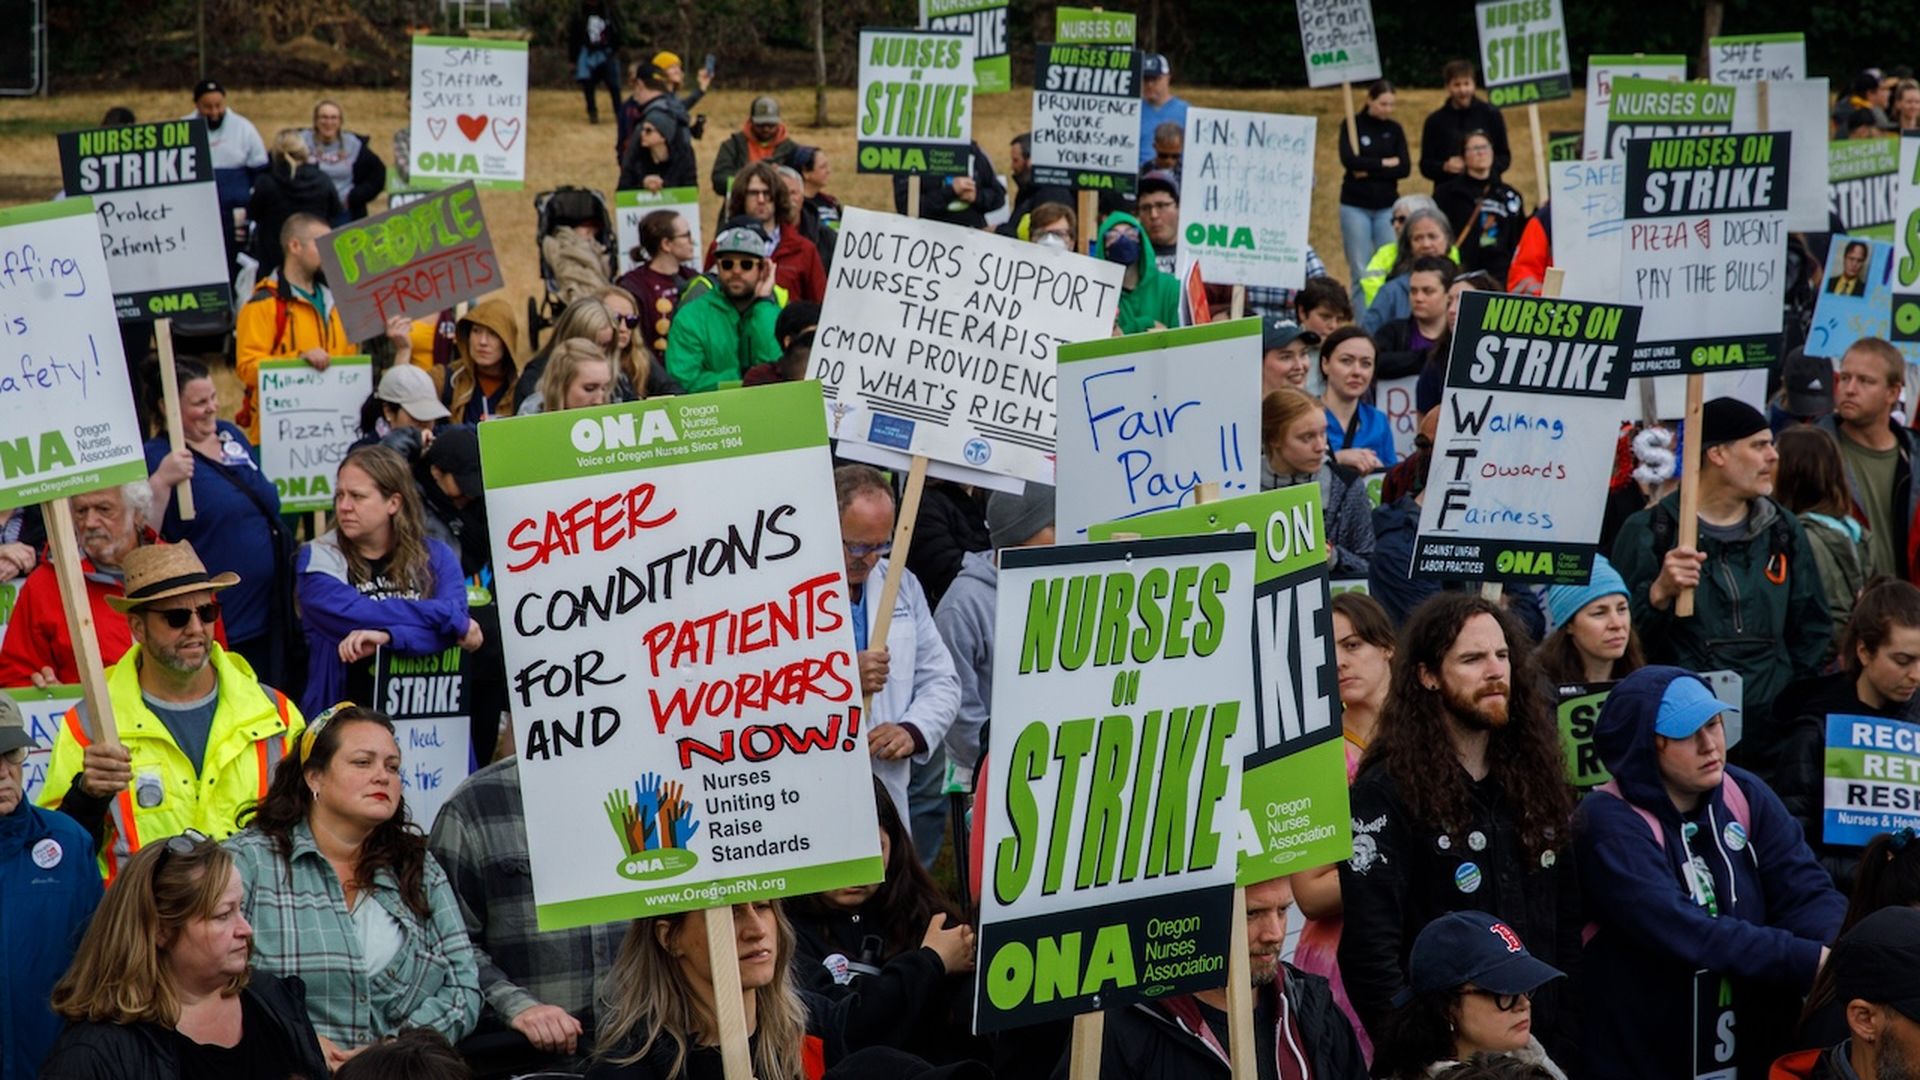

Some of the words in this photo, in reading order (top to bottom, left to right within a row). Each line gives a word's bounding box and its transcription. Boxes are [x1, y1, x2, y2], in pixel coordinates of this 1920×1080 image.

[1486, 0, 1551, 29] NURSES
[1060, 20, 1111, 38] NURSES
[1114, 21, 1132, 38] ON
[444, 48, 493, 67] SAFE
[869, 37, 962, 69] NURSES
[1050, 47, 1107, 67] NURSES
[1110, 51, 1132, 69] ON
[1311, 50, 1348, 65] ONA
[1487, 29, 1560, 81] STRIKE
[1719, 44, 1763, 63] SAFE
[1046, 65, 1132, 95] STRIKE
[422, 91, 475, 109] SAVES
[1038, 93, 1138, 116] PROVIDENCE
[1490, 83, 1540, 106] ONA
[1615, 92, 1696, 115] NURSES
[1701, 93, 1732, 114] ON
[861, 81, 969, 138] STRIKE
[1053, 114, 1103, 129] YOU'RE
[78, 124, 158, 157] NURSES
[162, 122, 190, 147] ON
[1649, 137, 1737, 169] NURSES
[1741, 135, 1774, 165] ON
[79, 147, 198, 192] STRIKE
[417, 151, 480, 174] ONA
[860, 146, 927, 171] ONA
[1057, 149, 1124, 167] YOURSELF
[1078, 174, 1113, 189] ONA
[1563, 165, 1623, 190] SAFE
[1643, 166, 1775, 213] STRIKE
[97, 201, 174, 228] Protect
[333, 188, 483, 284] PEOPLE
[1185, 222, 1256, 250] ONA
[1631, 222, 1688, 251] PIZZA
[0, 244, 87, 297] ffing
[843, 231, 965, 279] DOCTORS
[974, 252, 1115, 318] SUPPORT
[1636, 266, 1672, 300] PAY
[1680, 263, 1716, 294] THE
[1725, 259, 1775, 295] BILLS!
[372, 251, 493, 325] PROFITS
[836, 266, 942, 302] NURSES
[963, 290, 1022, 321] AND
[149, 293, 199, 313] ONA
[5, 315, 28, 335] is
[1481, 297, 1582, 339] NURSES
[1584, 306, 1624, 341] ON
[0, 334, 101, 399] afety!
[820, 325, 896, 359] C'MON
[906, 339, 1057, 406] PROVIDENC
[1469, 334, 1619, 392] STRIKE
[1691, 344, 1745, 367] ONA
[816, 357, 844, 386] DO
[860, 365, 959, 413] WHAT'S
[679, 403, 719, 419] Oregon
[681, 414, 719, 429] Nurses
[1082, 366, 1201, 452] Fair
[1451, 392, 1565, 440] Walking
[74, 421, 111, 440] Oregon
[76, 436, 112, 452] Nurses
[570, 408, 680, 453] ONA
[682, 423, 741, 440] Association
[80, 443, 134, 465] Association
[289, 441, 348, 469] NURSE
[576, 453, 603, 469] Voice
[605, 452, 616, 465] of
[616, 446, 654, 466] Oregon
[655, 443, 690, 459] Nurses
[691, 439, 719, 454] Since
[720, 436, 744, 451] 1904
[1445, 448, 1566, 481] Towards
[18, 471, 100, 498] www.OregonRN.org
[1117, 449, 1202, 509] Pay
[1436, 488, 1554, 531] Fairness
[506, 482, 677, 573] SAFER
[1265, 500, 1315, 564] ON
[1422, 543, 1452, 557] AGAINST
[1453, 545, 1481, 559] UNFAIR
[1496, 550, 1554, 577] ONA
[1558, 552, 1581, 564] Oregon
[514, 504, 801, 637] CONDITIONS
[1419, 559, 1445, 573] LABOR
[1446, 560, 1485, 575] PRACTICES
[1019, 562, 1231, 676] NURSES
[514, 649, 627, 707] FOR
[642, 572, 844, 677] PATIENTS
[442, 646, 461, 672] ON
[385, 675, 462, 716] STRIKE
[1111, 669, 1140, 706] ON
[526, 705, 622, 761] AND
[647, 650, 855, 735] WORKERS
[409, 724, 446, 750] Need
[676, 705, 863, 770] NOW!
[702, 769, 771, 791] Nurses
[705, 793, 776, 815] Uniting
[781, 789, 800, 804] to
[993, 700, 1241, 905] STRIKE
[1266, 797, 1311, 818] Oregon
[708, 819, 763, 839] Raise
[1268, 814, 1310, 835] Nurses
[1838, 811, 1878, 826] Nurses
[1881, 815, 1891, 828] &
[711, 834, 811, 863] Standards
[1269, 824, 1336, 851] Association
[625, 857, 665, 875] ONA
[644, 876, 786, 907] www.OregonRN.org
[1147, 916, 1200, 939] Oregon
[1145, 937, 1196, 962] Nurses
[987, 923, 1137, 1010] ONA
[1143, 954, 1223, 983] Association
